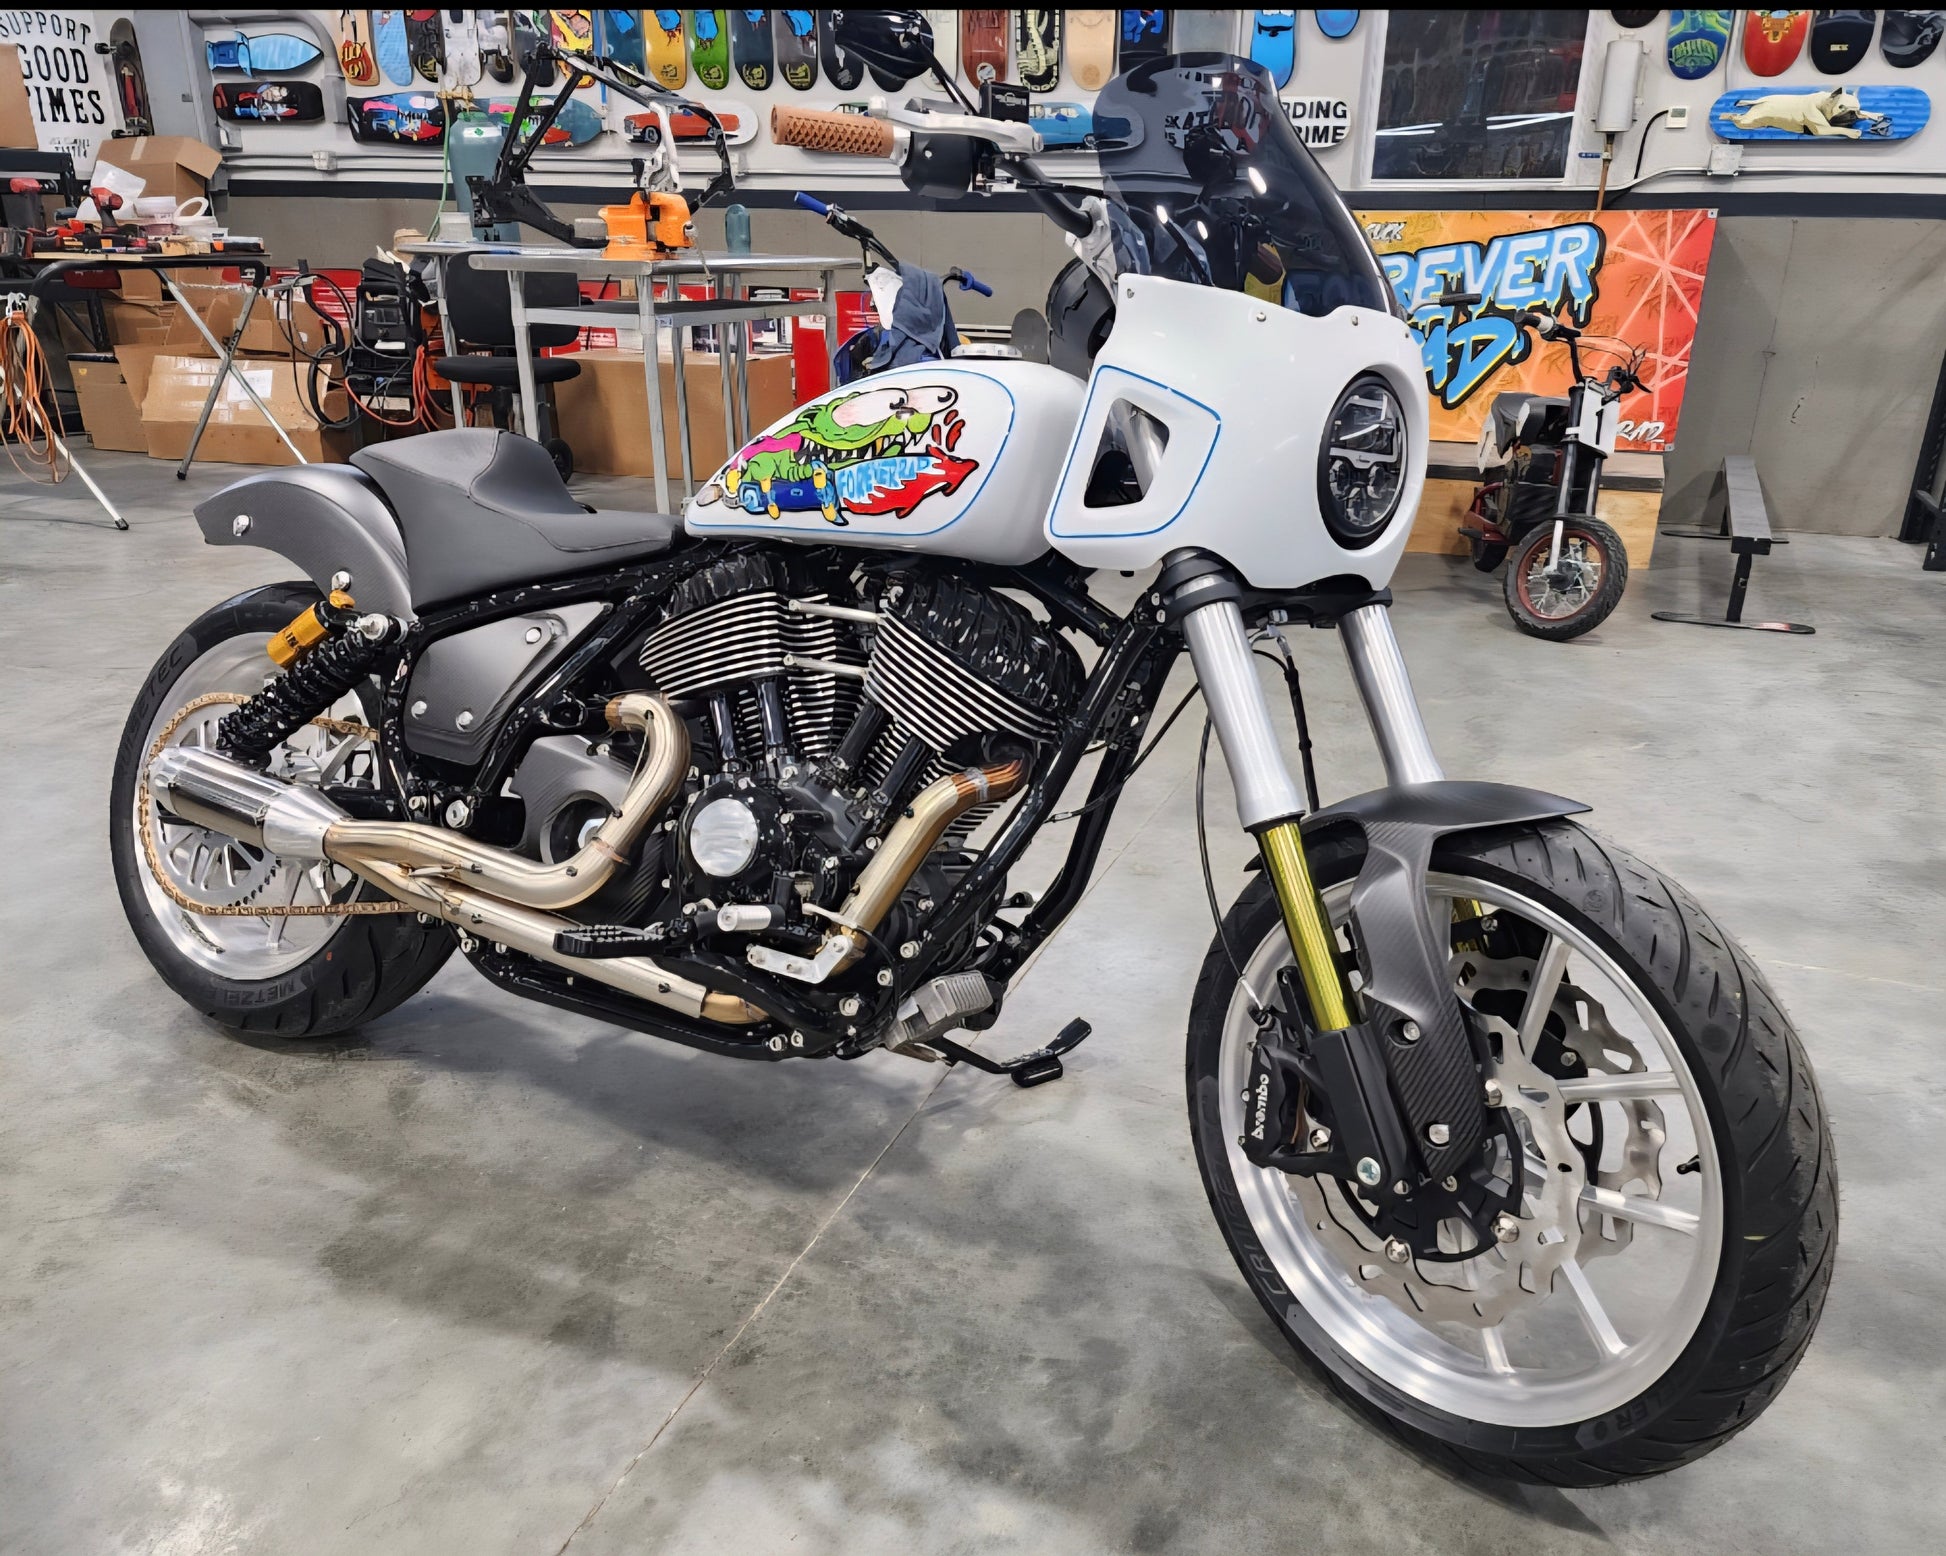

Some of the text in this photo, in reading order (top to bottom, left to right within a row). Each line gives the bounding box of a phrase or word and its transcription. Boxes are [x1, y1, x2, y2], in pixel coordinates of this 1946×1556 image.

[0, 11, 91, 45] SUPPORT
[17, 43, 89, 84] GOOD
[25, 85, 105, 125] IMES
[1294, 125, 1346, 144] IME
